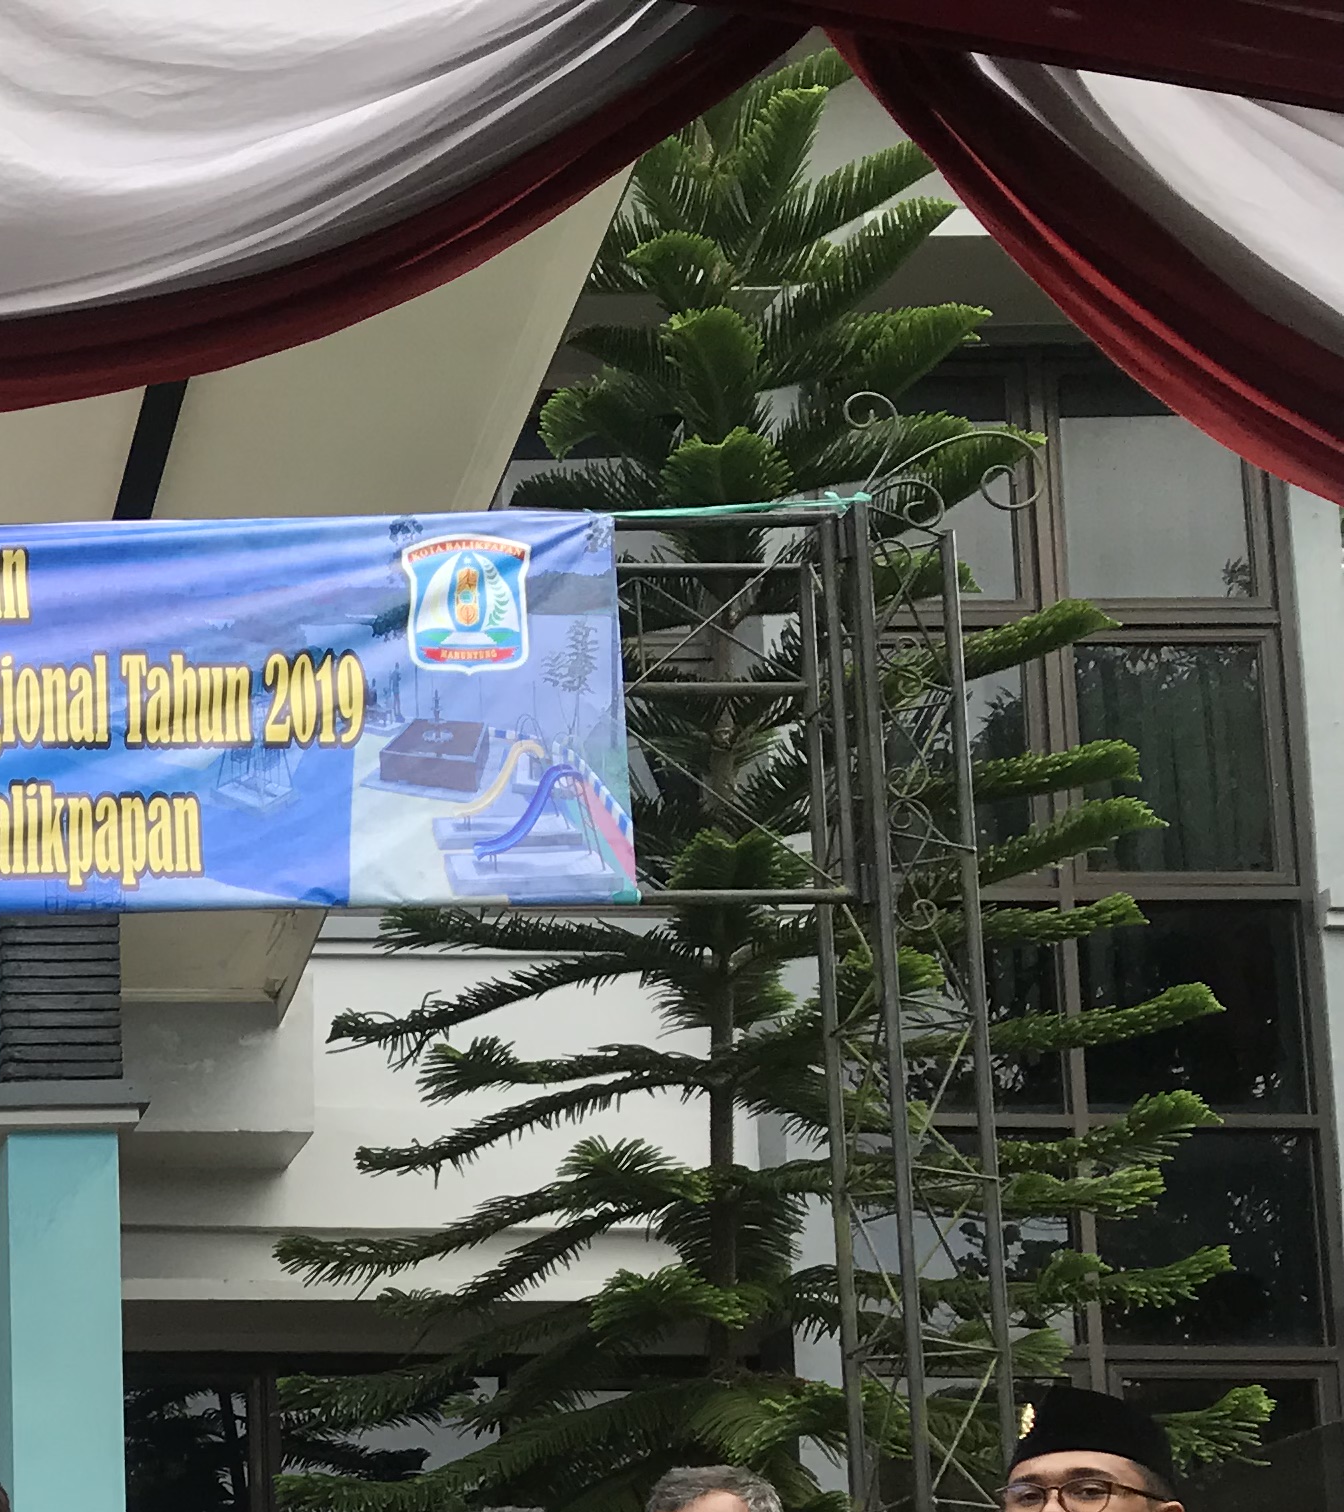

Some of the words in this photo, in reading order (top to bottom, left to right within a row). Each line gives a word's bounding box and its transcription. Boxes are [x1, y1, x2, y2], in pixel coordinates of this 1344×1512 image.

[411, 543, 443, 560] KOTA
[446, 540, 522, 557] BALIKPAPAN
[120, 652, 253, 745] Tahun
[263, 651, 366, 745] 2019
